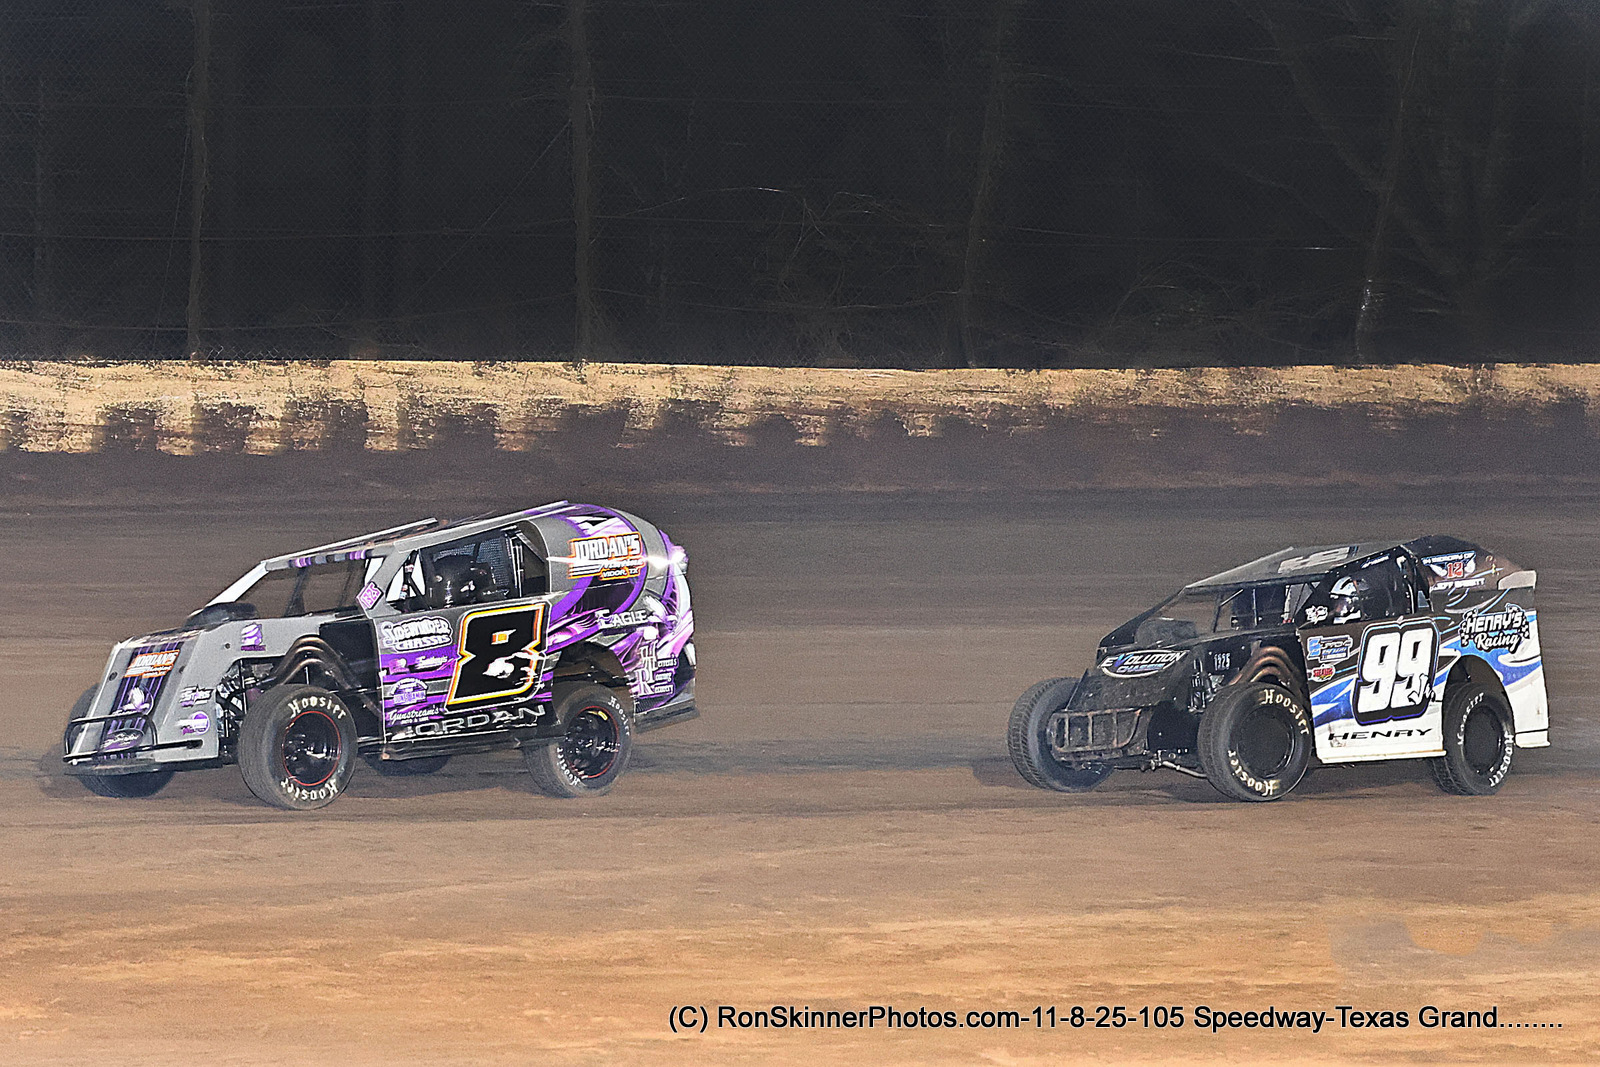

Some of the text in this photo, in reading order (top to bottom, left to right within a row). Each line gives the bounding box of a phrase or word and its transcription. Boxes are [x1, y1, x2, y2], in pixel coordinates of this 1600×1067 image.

[574, 534, 640, 559] JORDAN'S
[1447, 561, 1464, 578] 12
[1465, 612, 1523, 634] HENRY'S
[1475, 632, 1521, 653] Racing
[446, 602, 548, 708] 8
[1100, 650, 1187, 667] EVOLUTION
[1355, 621, 1438, 722] 99
[1328, 728, 1432, 741] HENRY
